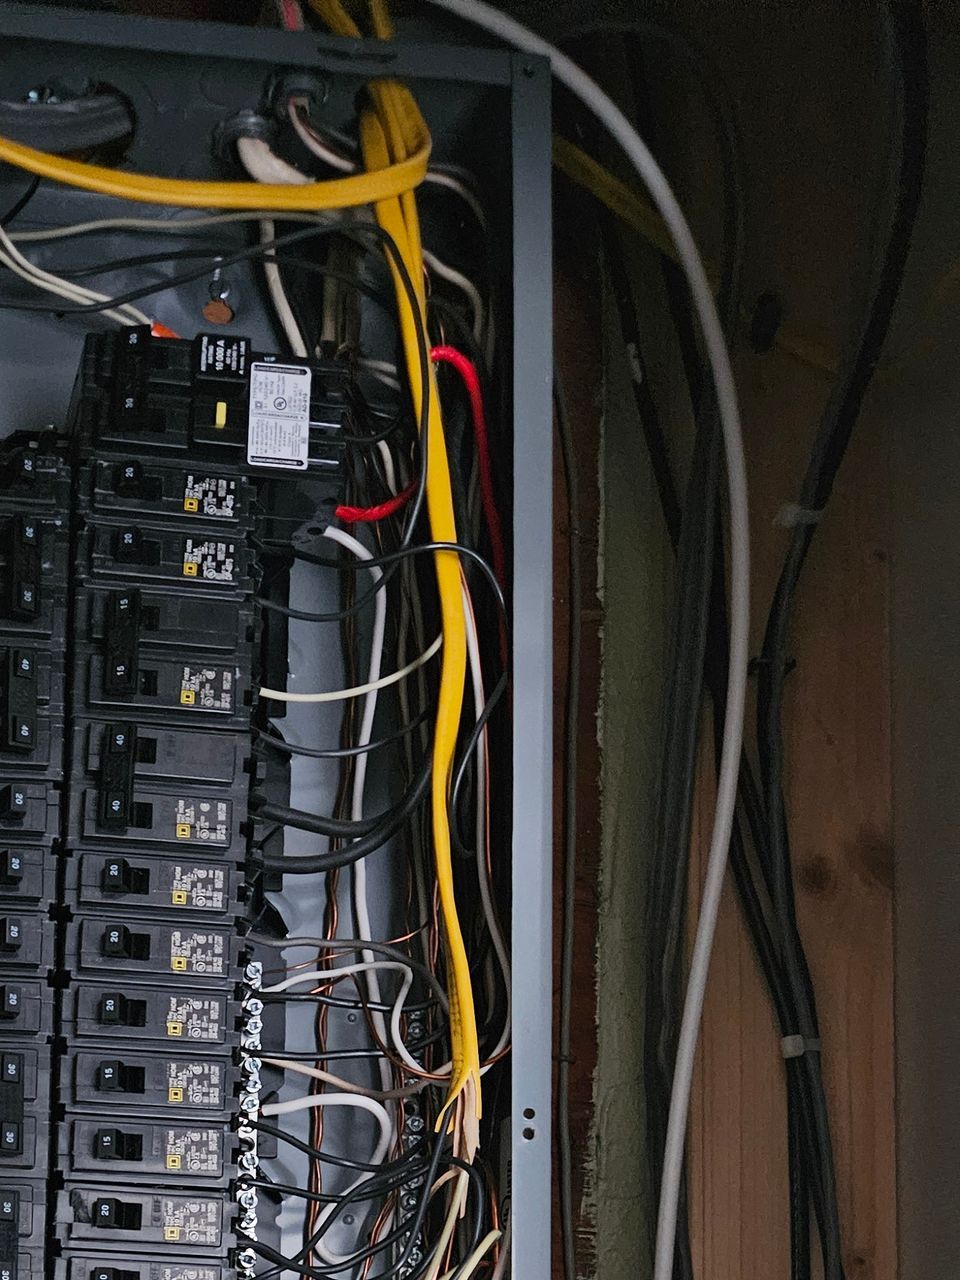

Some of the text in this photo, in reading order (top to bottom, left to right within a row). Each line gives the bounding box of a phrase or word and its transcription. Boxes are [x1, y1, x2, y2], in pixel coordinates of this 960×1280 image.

[216, 347, 224, 361] 000
[216, 362, 223, 370] 10
[24, 459, 33, 471] 20
[125, 467, 134, 478] 20
[25, 526, 34, 538] 30
[123, 533, 133, 544] 20
[23, 590, 33, 602] 30
[119, 598, 129, 610] 15
[21, 658, 30, 670] 40
[116, 665, 125, 676] 15
[20, 724, 29, 736] 40
[115, 734, 125, 746] 40
[15, 792, 24, 805] 20
[111, 800, 121, 811] 40
[11, 857, 20, 870] 20
[109, 864, 119, 876] 20
[10, 925, 19, 938] 20
[109, 931, 119, 943] 20
[8, 993, 18, 1005] 20
[105, 999, 115, 1011] 20
[7, 1063, 16, 1075] 30
[104, 1067, 113, 1079] 15
[5, 1131, 15, 1143] 30
[102, 1136, 111, 1146] 15
[3, 1201, 12, 1213] 30
[100, 1204, 110, 1216] 20
